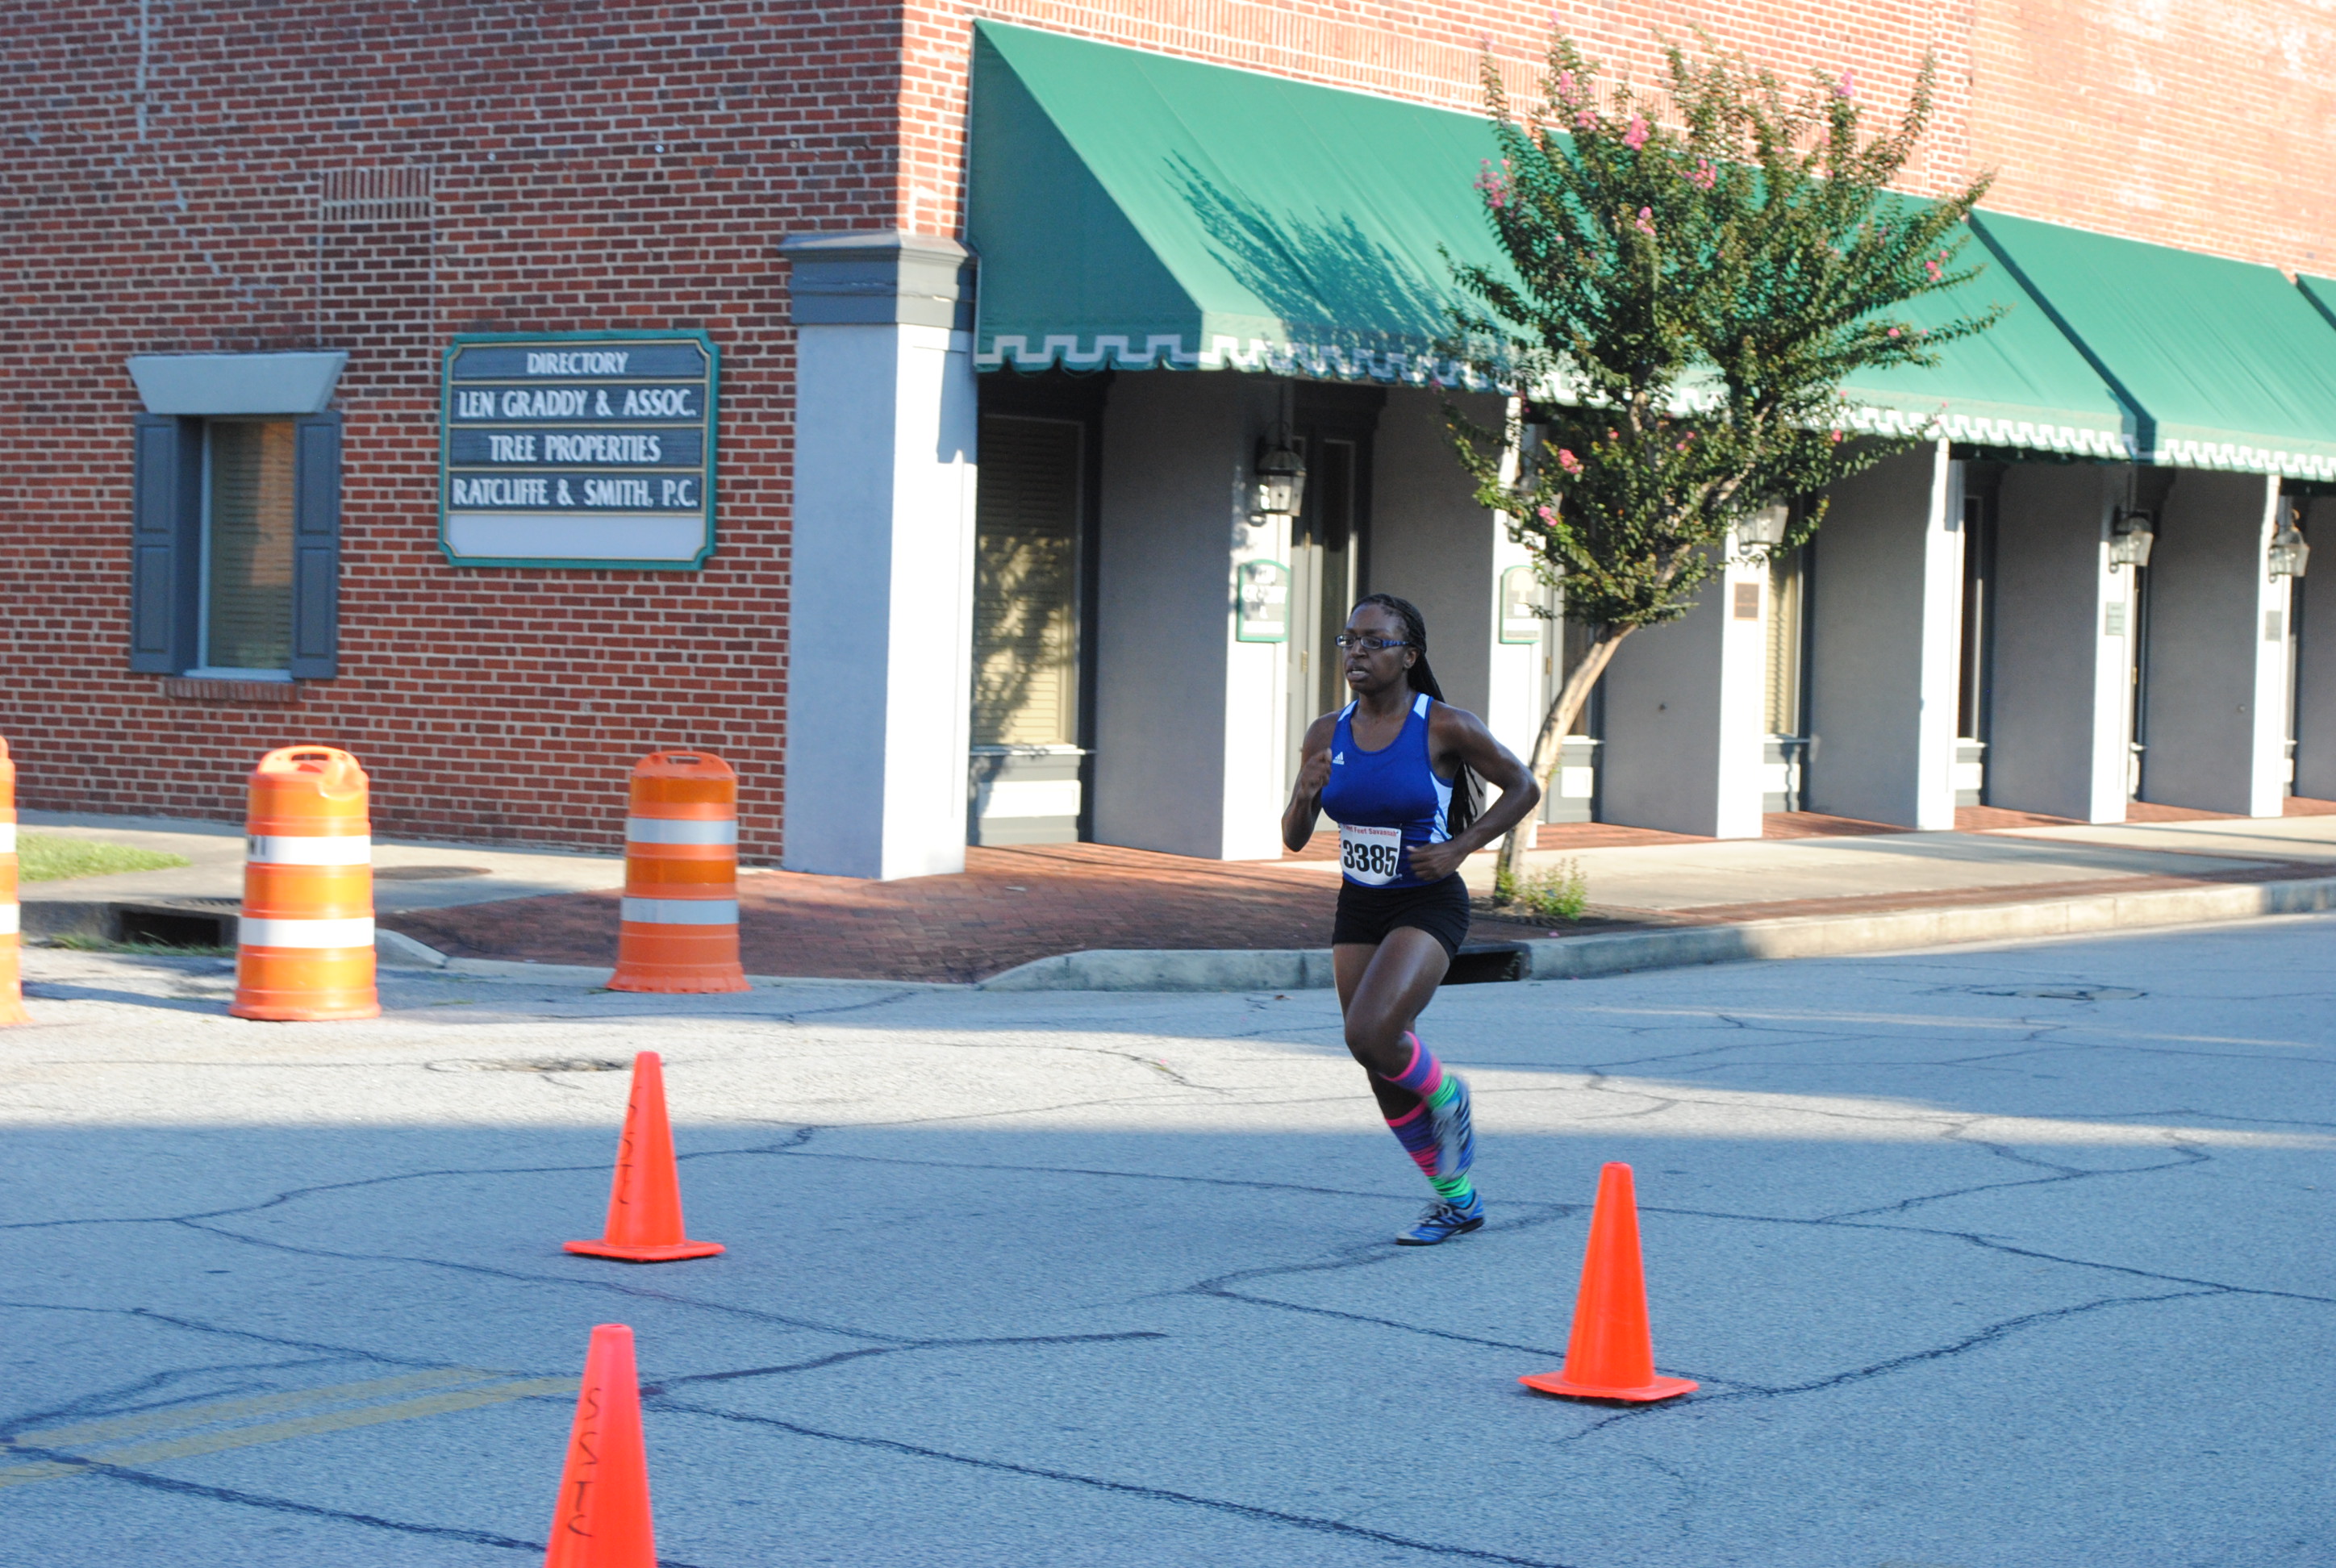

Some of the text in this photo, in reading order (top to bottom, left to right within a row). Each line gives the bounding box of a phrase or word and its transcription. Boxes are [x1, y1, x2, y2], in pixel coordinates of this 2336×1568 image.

[528, 352, 628, 374] DIRECTORY
[459, 389, 697, 417] LEN GRADDY & ASSOC.
[488, 435, 662, 462] TREE PROPERTIES
[452, 478, 699, 508] RATCLIFFE & SMITH, P.C.
[1343, 840, 1398, 877] 3385
